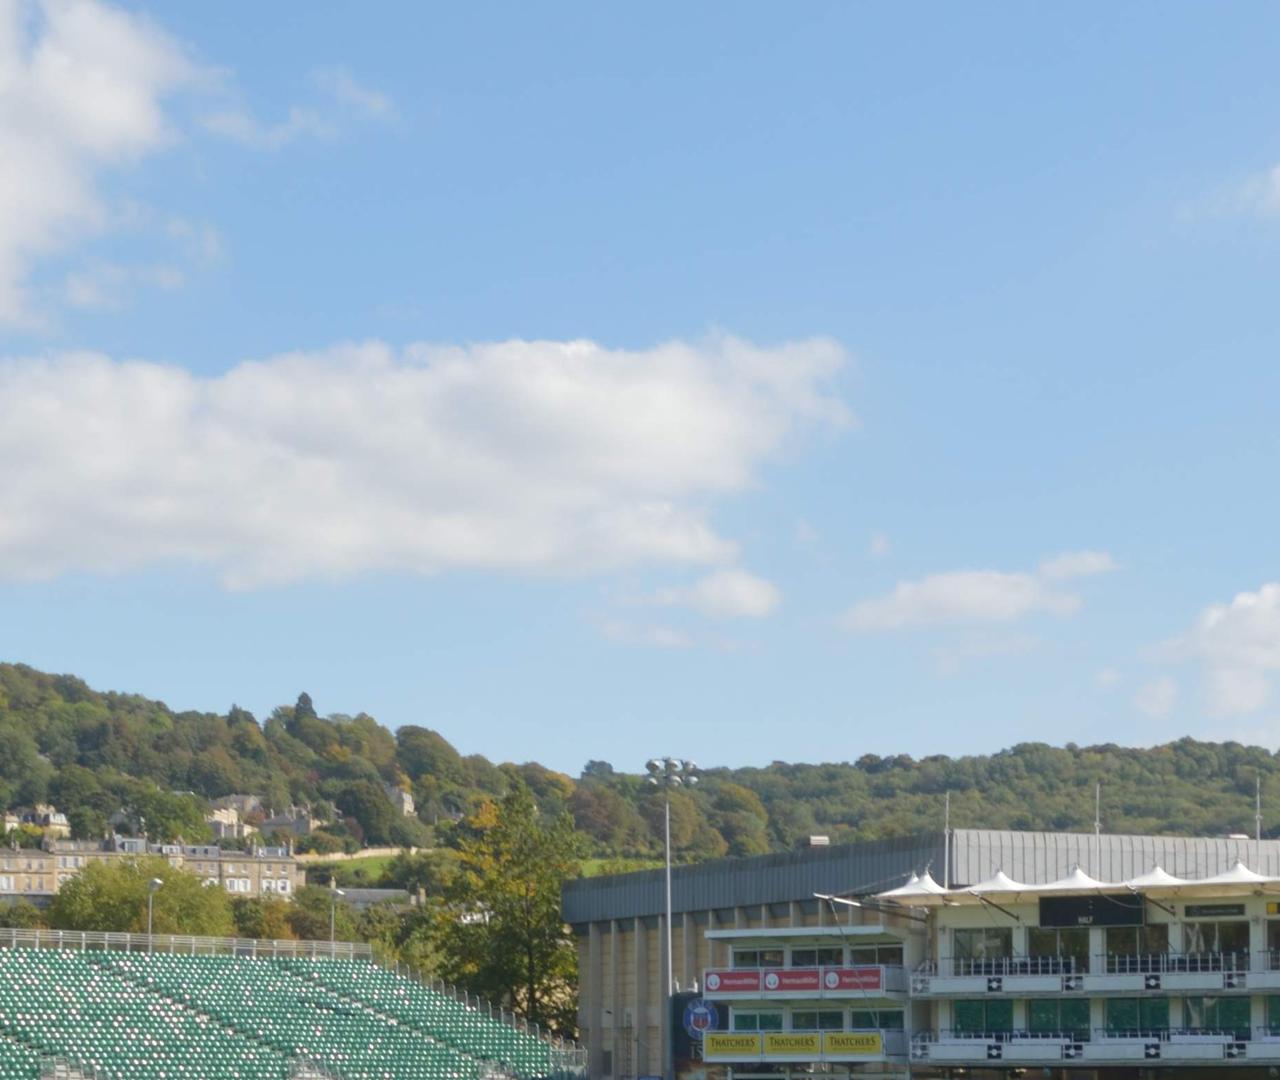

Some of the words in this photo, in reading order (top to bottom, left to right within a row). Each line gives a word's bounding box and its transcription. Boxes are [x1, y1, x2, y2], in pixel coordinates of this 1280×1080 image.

[710, 1037, 756, 1048] THATCHERS
[770, 1036, 816, 1047] THATCHERS
[829, 1036, 876, 1047] THATCHERS
